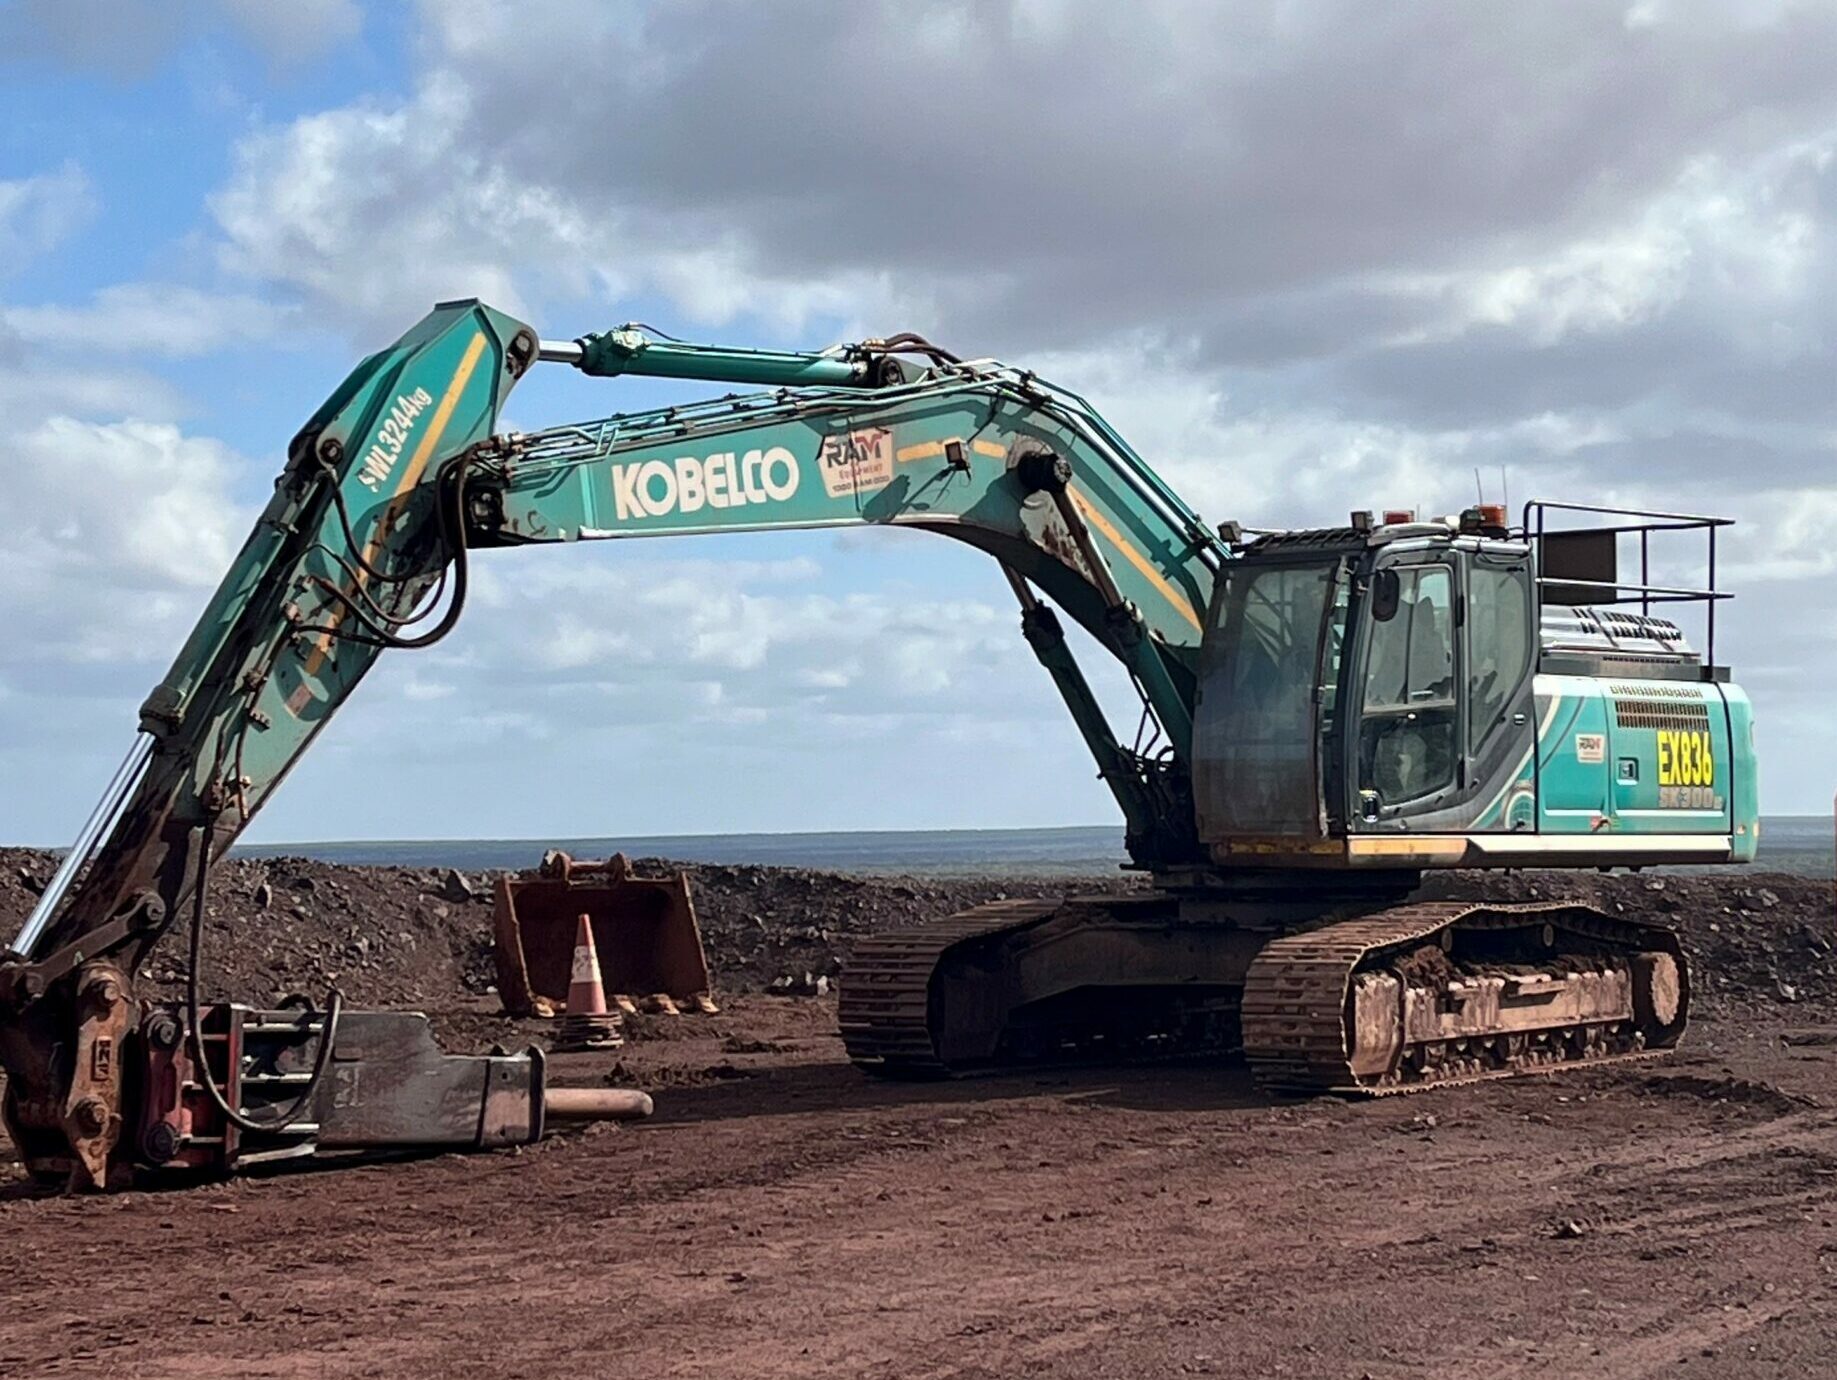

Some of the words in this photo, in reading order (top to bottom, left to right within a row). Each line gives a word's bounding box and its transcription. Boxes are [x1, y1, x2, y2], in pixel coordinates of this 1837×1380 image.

[825, 433, 883, 468] RAM
[611, 446, 800, 521] KOBELCO
[1656, 730, 1714, 786] EX836
